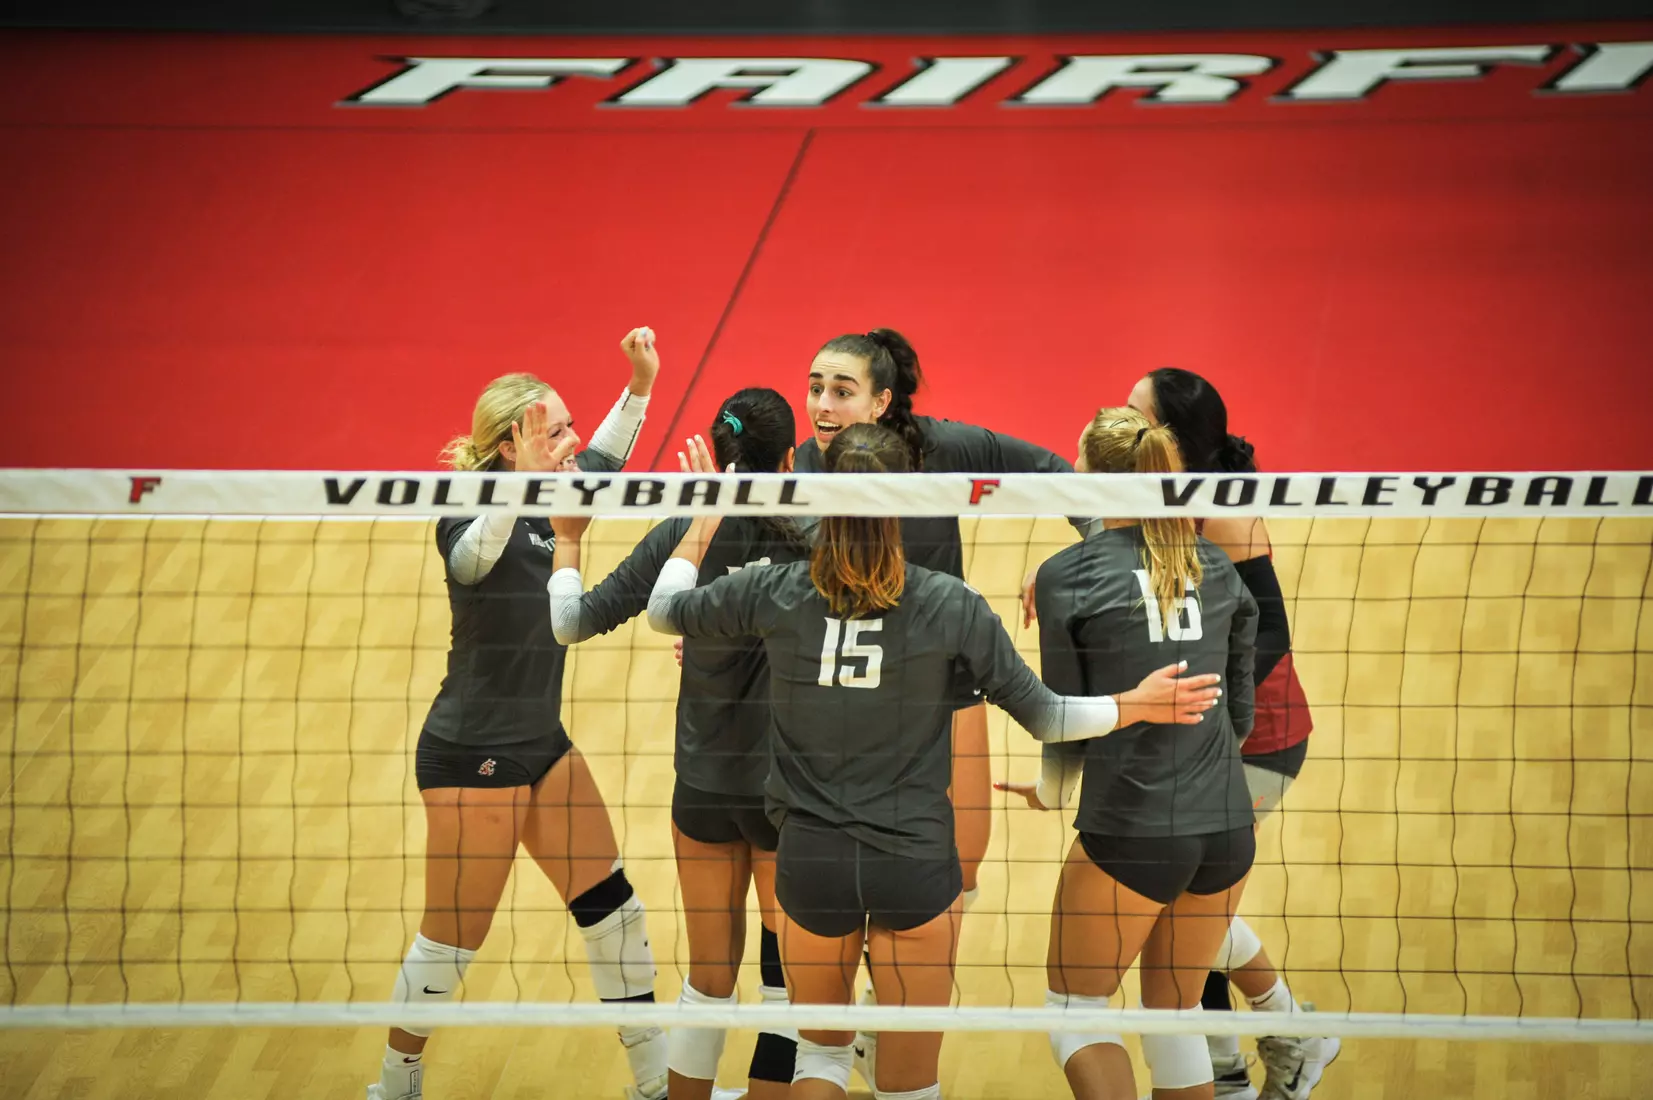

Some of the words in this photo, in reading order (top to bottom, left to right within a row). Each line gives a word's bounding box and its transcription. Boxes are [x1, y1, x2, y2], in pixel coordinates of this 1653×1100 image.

[128, 476, 162, 504] F
[325, 477, 809, 507] VOLLEYBALL
[968, 478, 1001, 505] F
[818, 617, 883, 688] 15
